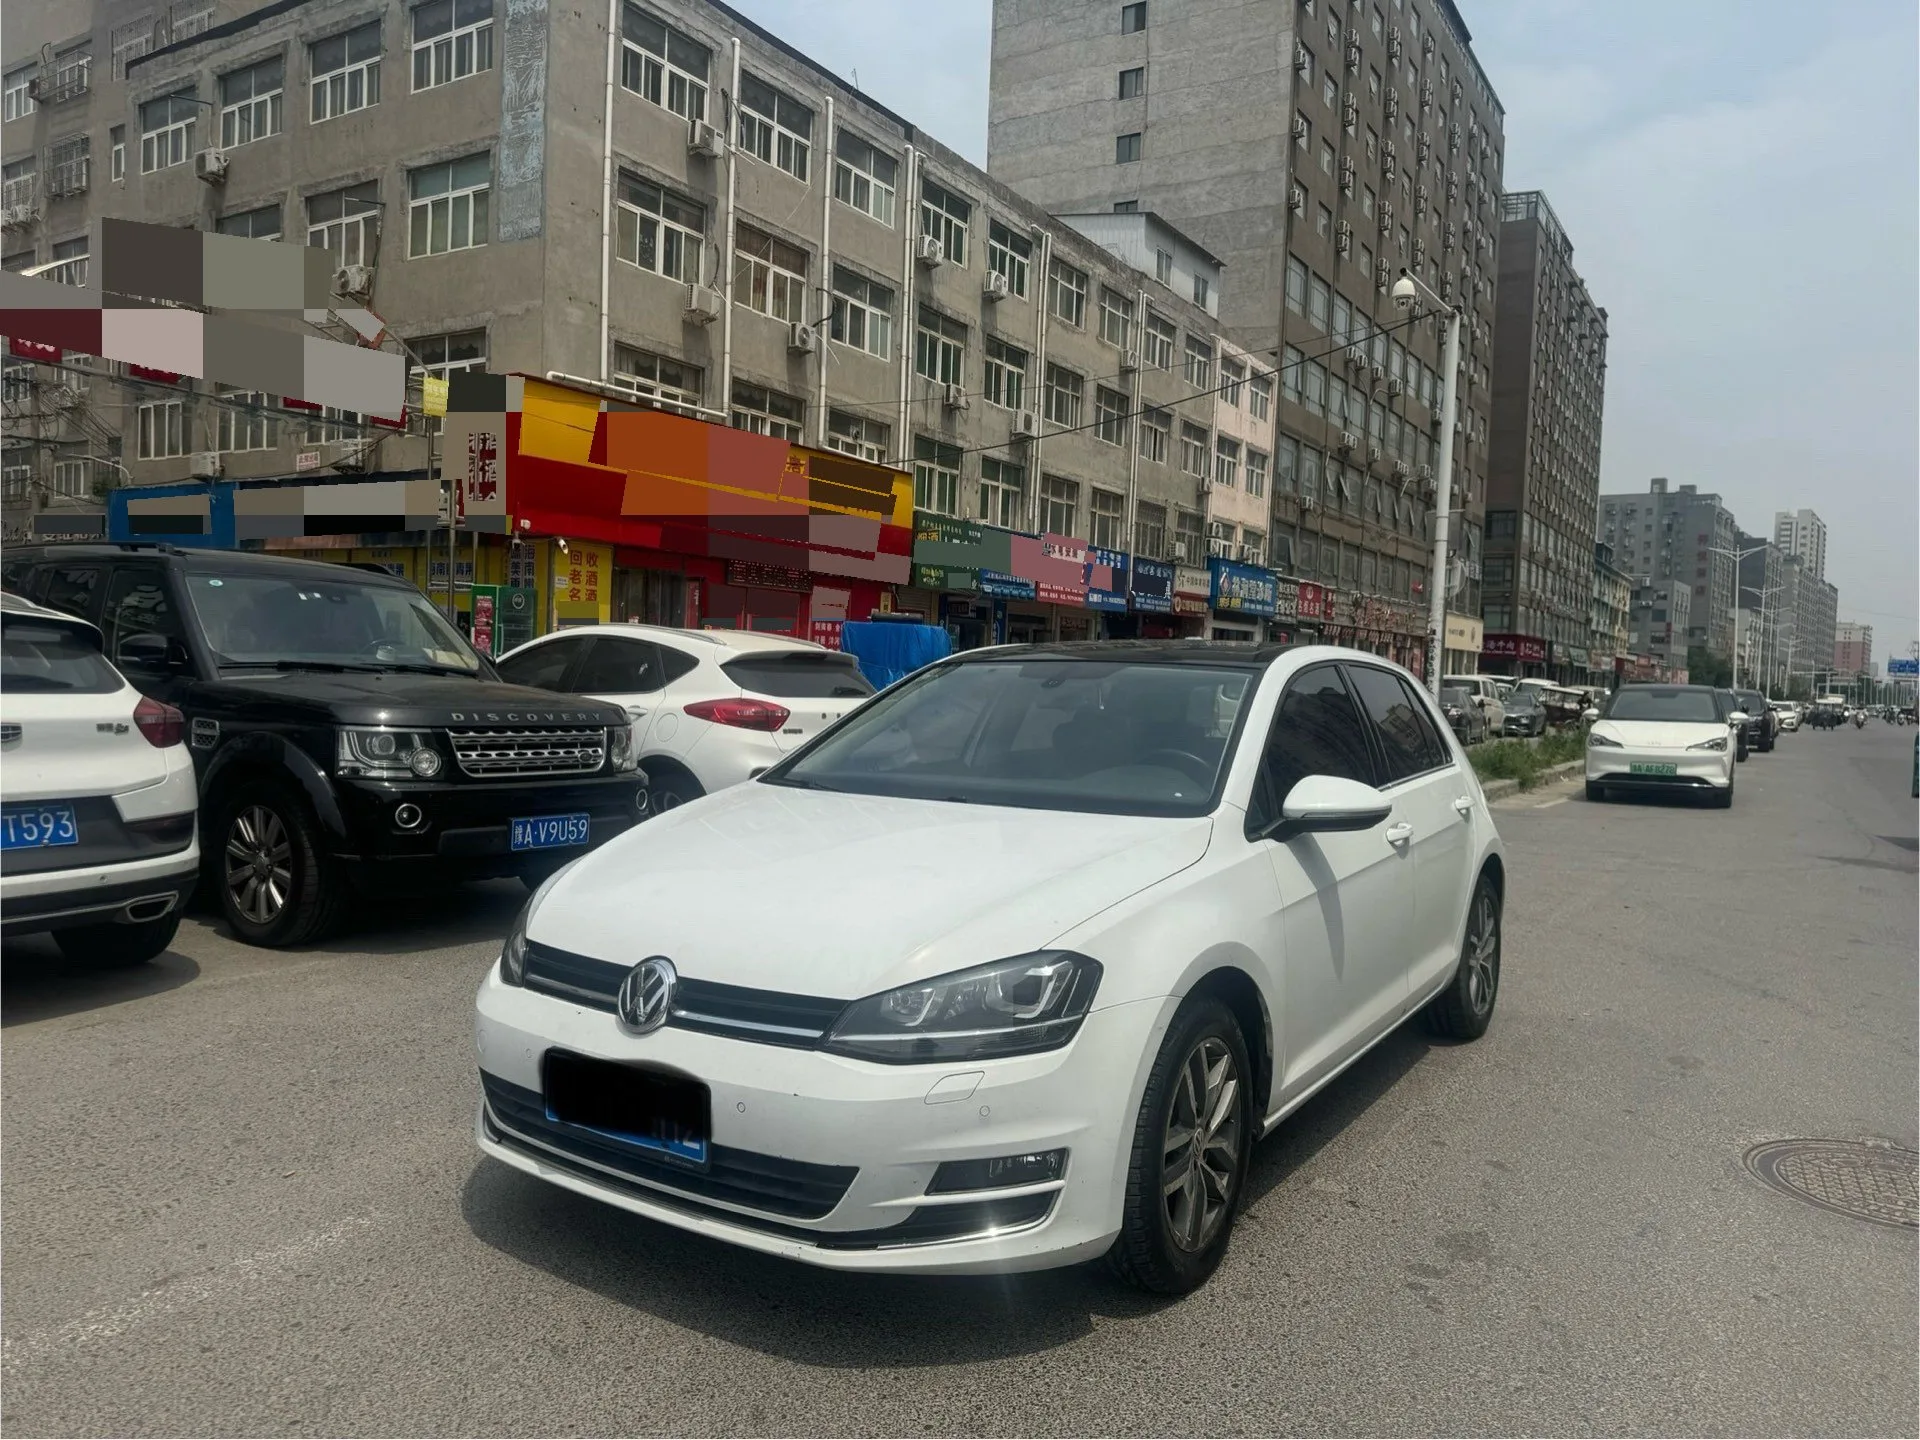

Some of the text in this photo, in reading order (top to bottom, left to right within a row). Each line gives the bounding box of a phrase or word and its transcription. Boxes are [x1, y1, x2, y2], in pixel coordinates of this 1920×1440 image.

[570, 550, 599, 568] 回收
[569, 568, 598, 587] 老酒
[451, 712, 601, 722] DISCOVERY
[2, 811, 73, 843] T593
